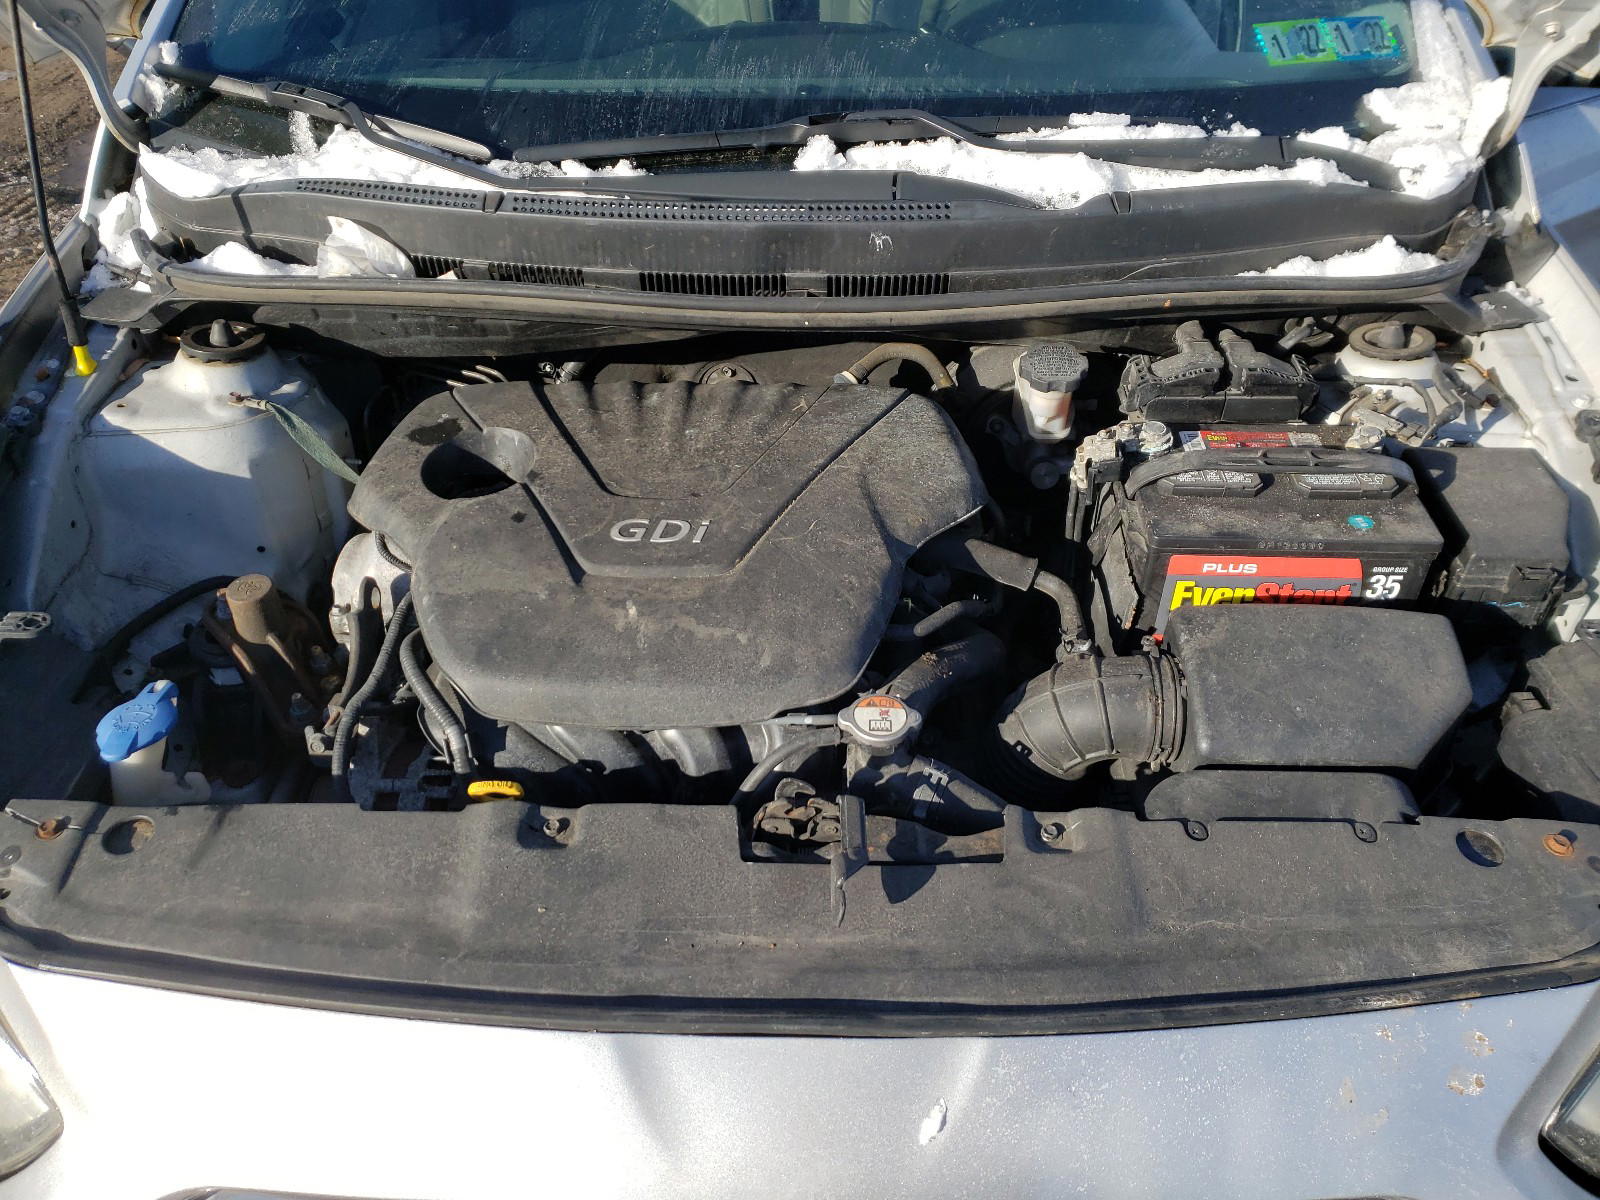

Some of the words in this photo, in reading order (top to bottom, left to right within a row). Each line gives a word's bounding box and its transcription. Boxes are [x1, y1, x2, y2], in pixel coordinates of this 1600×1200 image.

[1271, 34, 1286, 58] 1
[1298, 25, 1327, 54] 22
[1334, 23, 1351, 52] 1
[1363, 21, 1392, 51] 22
[609, 518, 711, 543] GDi
[1202, 563, 1258, 574] PLUS
[1365, 574, 1404, 600] 35
